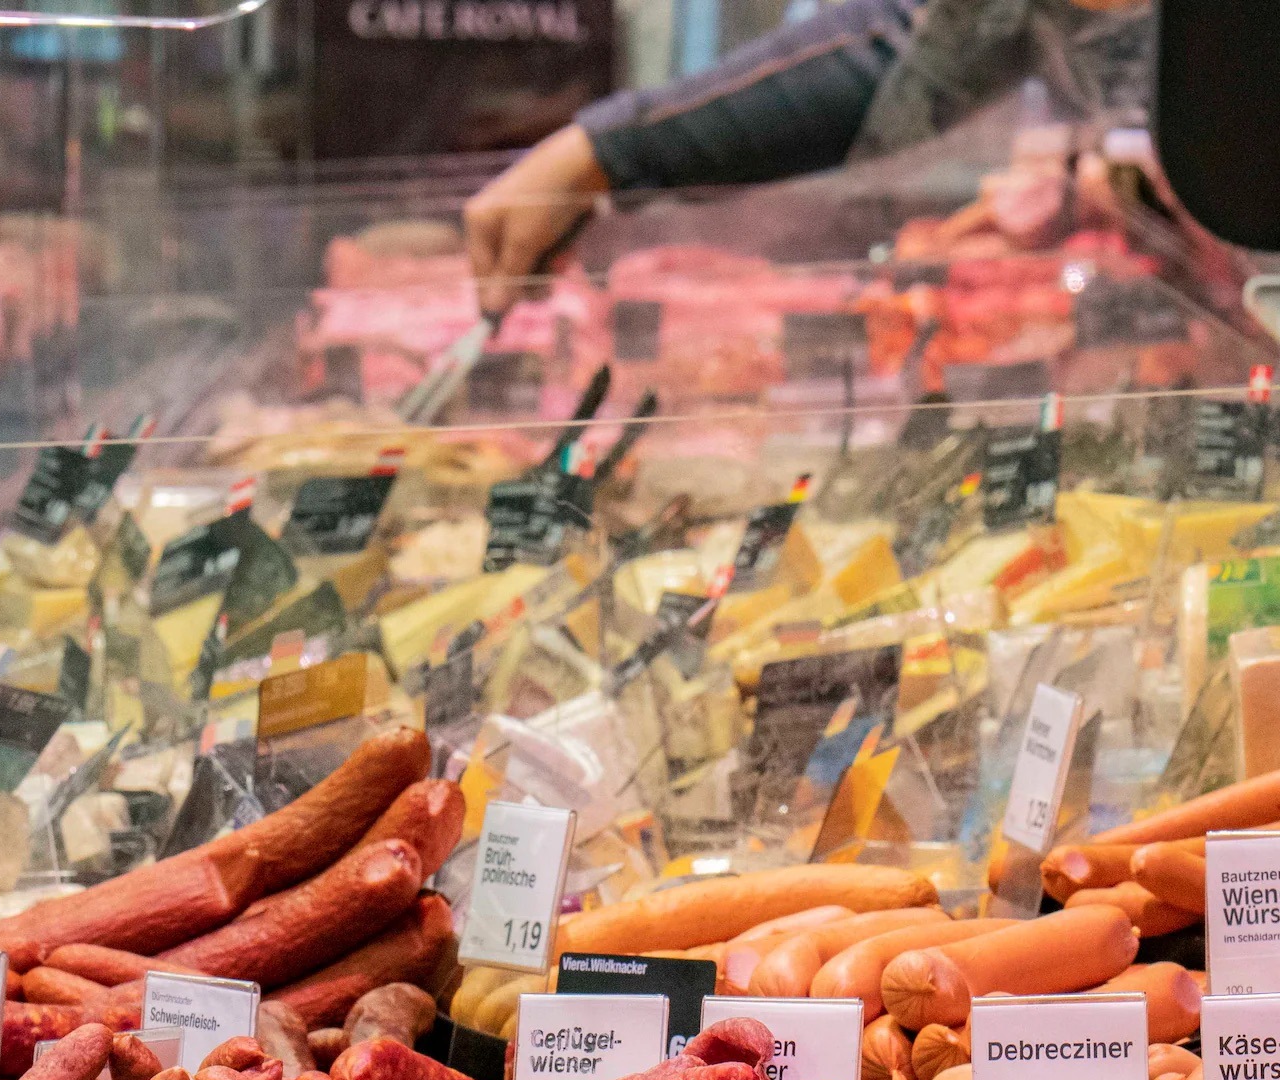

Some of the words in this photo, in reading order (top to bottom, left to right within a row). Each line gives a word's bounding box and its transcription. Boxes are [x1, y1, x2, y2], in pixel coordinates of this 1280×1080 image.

[485, 848, 516, 867] Brüh-
[482, 867, 537, 889] polnische
[504, 919, 542, 952] 1,19
[150, 1006, 220, 1031] Schweinefleisch-
[531, 1027, 622, 1053] Geflügel-
[988, 1038, 1133, 1061] Debrecziner
[530, 1051, 602, 1074] wiener
